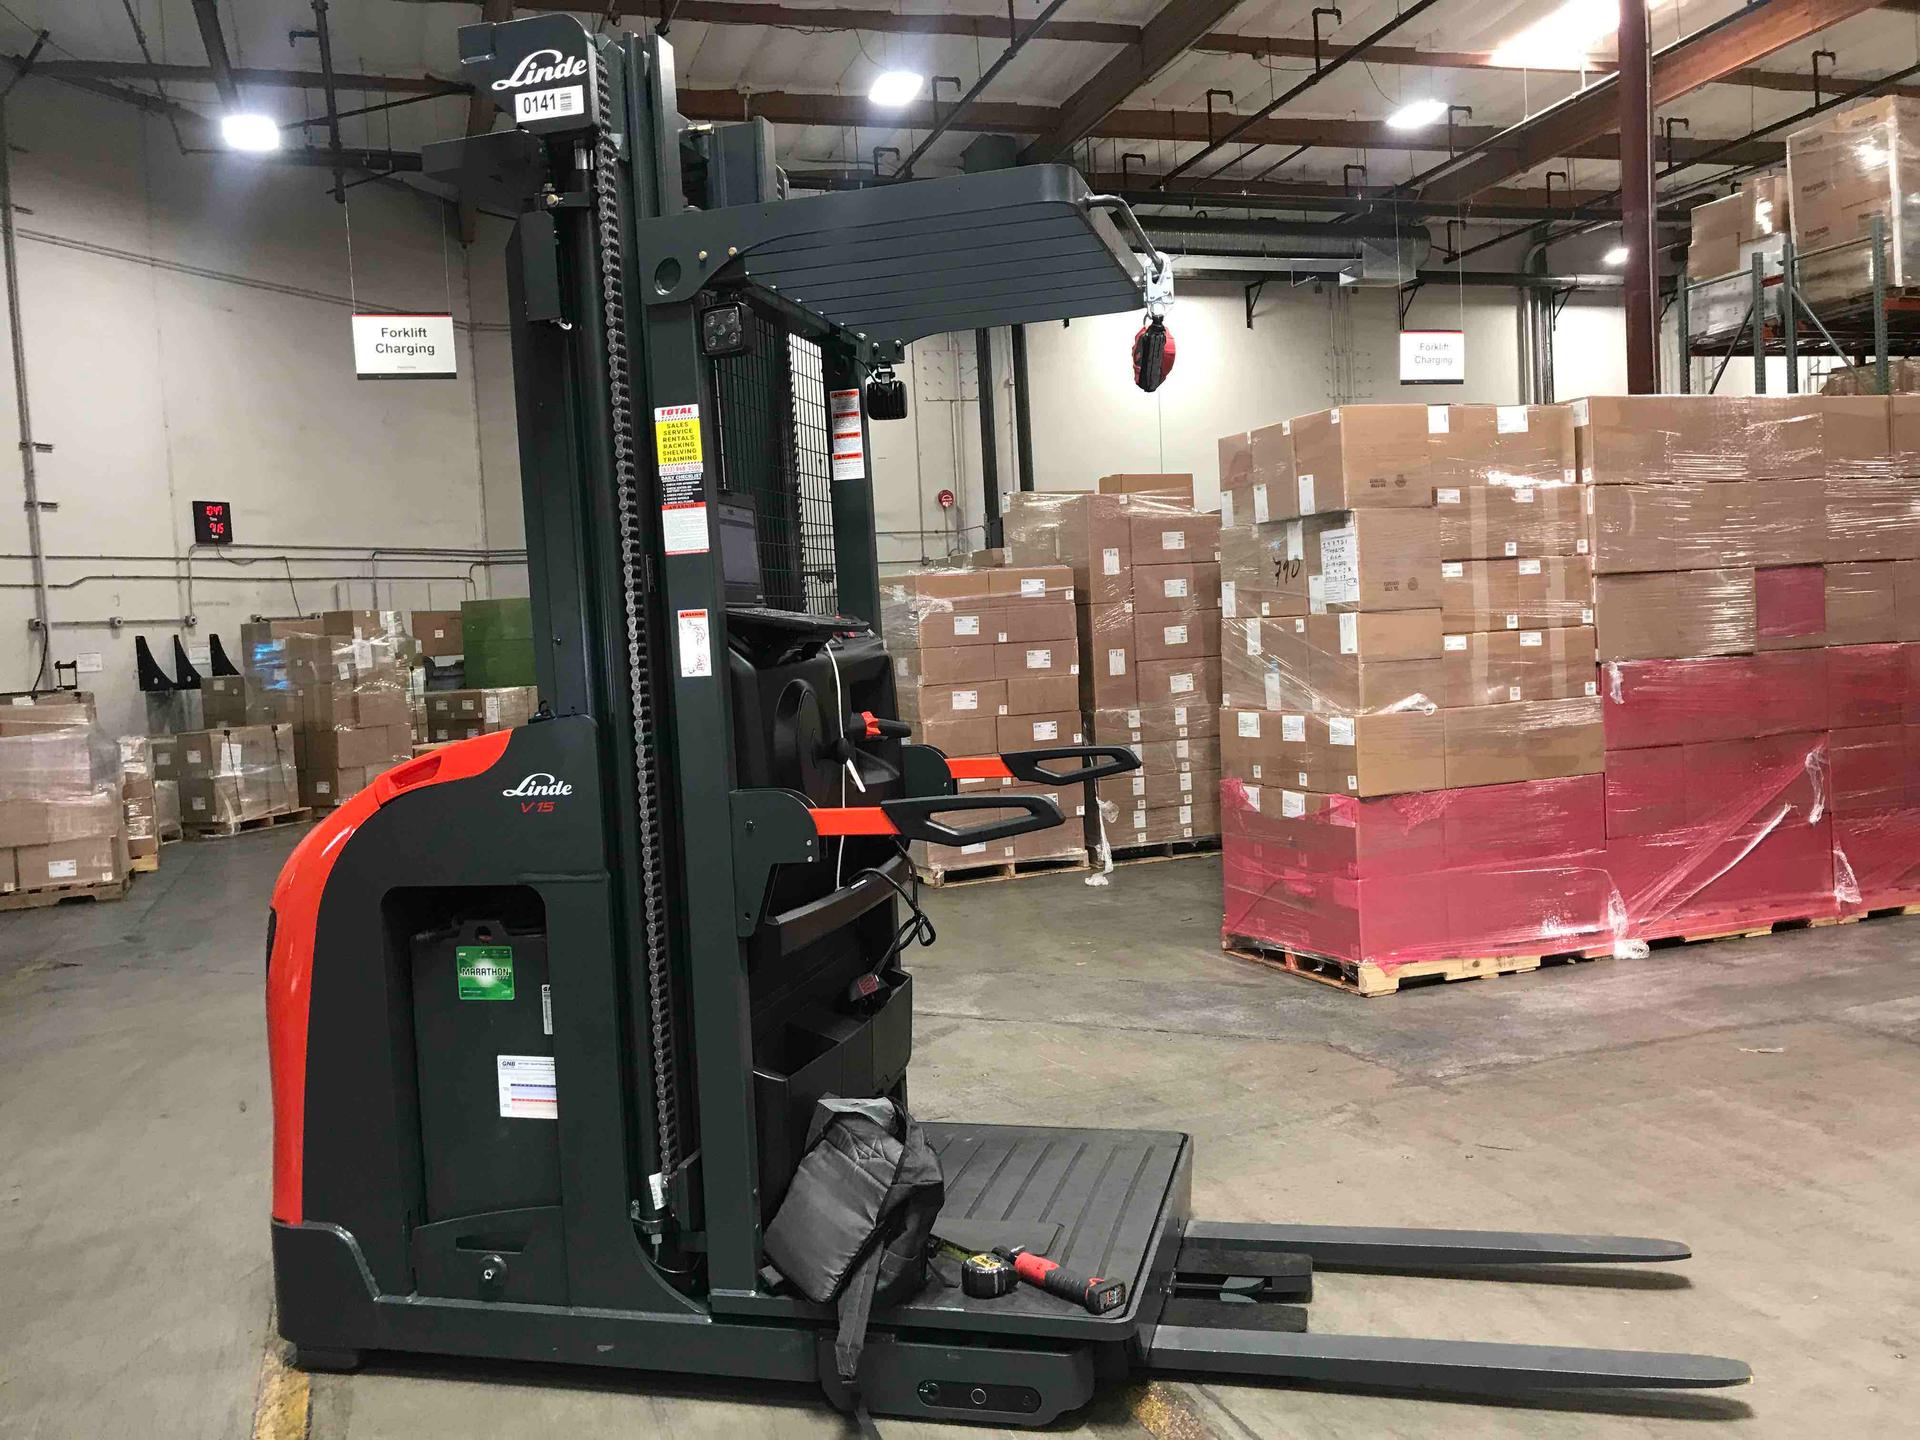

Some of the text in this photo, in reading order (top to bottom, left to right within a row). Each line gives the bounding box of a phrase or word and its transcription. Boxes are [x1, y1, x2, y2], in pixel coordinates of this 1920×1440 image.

[491, 49, 587, 91] Linde
[523, 92, 557, 114] 0141
[381, 327, 428, 338] Forklift
[375, 343, 435, 356] Charging
[1419, 342, 1449, 351] Forklift
[1413, 354, 1453, 366] Charging
[660, 407, 692, 416] TOTAL
[663, 428, 693, 436] SERVICE
[662, 435, 695, 443] RENTALS
[663, 441, 695, 449] RACKING
[662, 448, 697, 456] SHELVING
[663, 454, 698, 463] TRAINING
[502, 772, 573, 797] Linde
[521, 801, 556, 813] V 15
[462, 967, 509, 976] MARATHON
